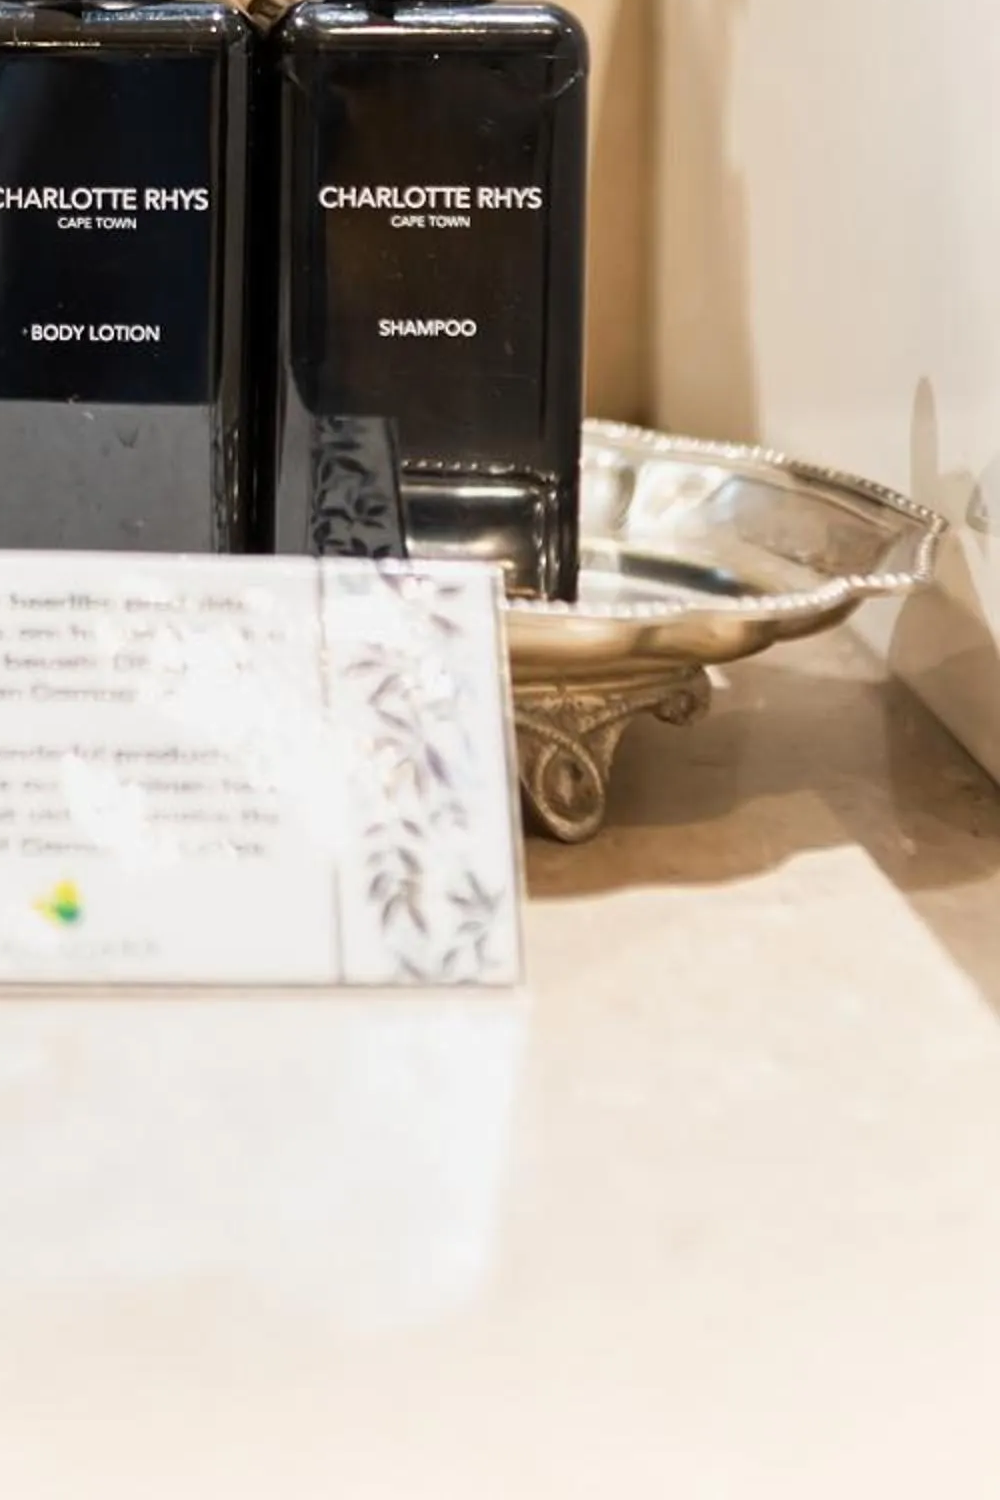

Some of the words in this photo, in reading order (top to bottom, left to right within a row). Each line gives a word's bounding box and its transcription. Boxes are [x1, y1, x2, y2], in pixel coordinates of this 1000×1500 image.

[144, 186, 209, 211] RHYS
[318, 185, 472, 210] CHARLOTTE
[476, 185, 543, 210] RHYS
[57, 216, 93, 230] CAPE
[95, 216, 137, 230] TOWN
[390, 214, 426, 229] CAPE
[427, 214, 471, 229] TOWN
[30, 323, 85, 343] BODY
[88, 323, 161, 343] LOTION
[378, 318, 477, 337] SHAMPOO
